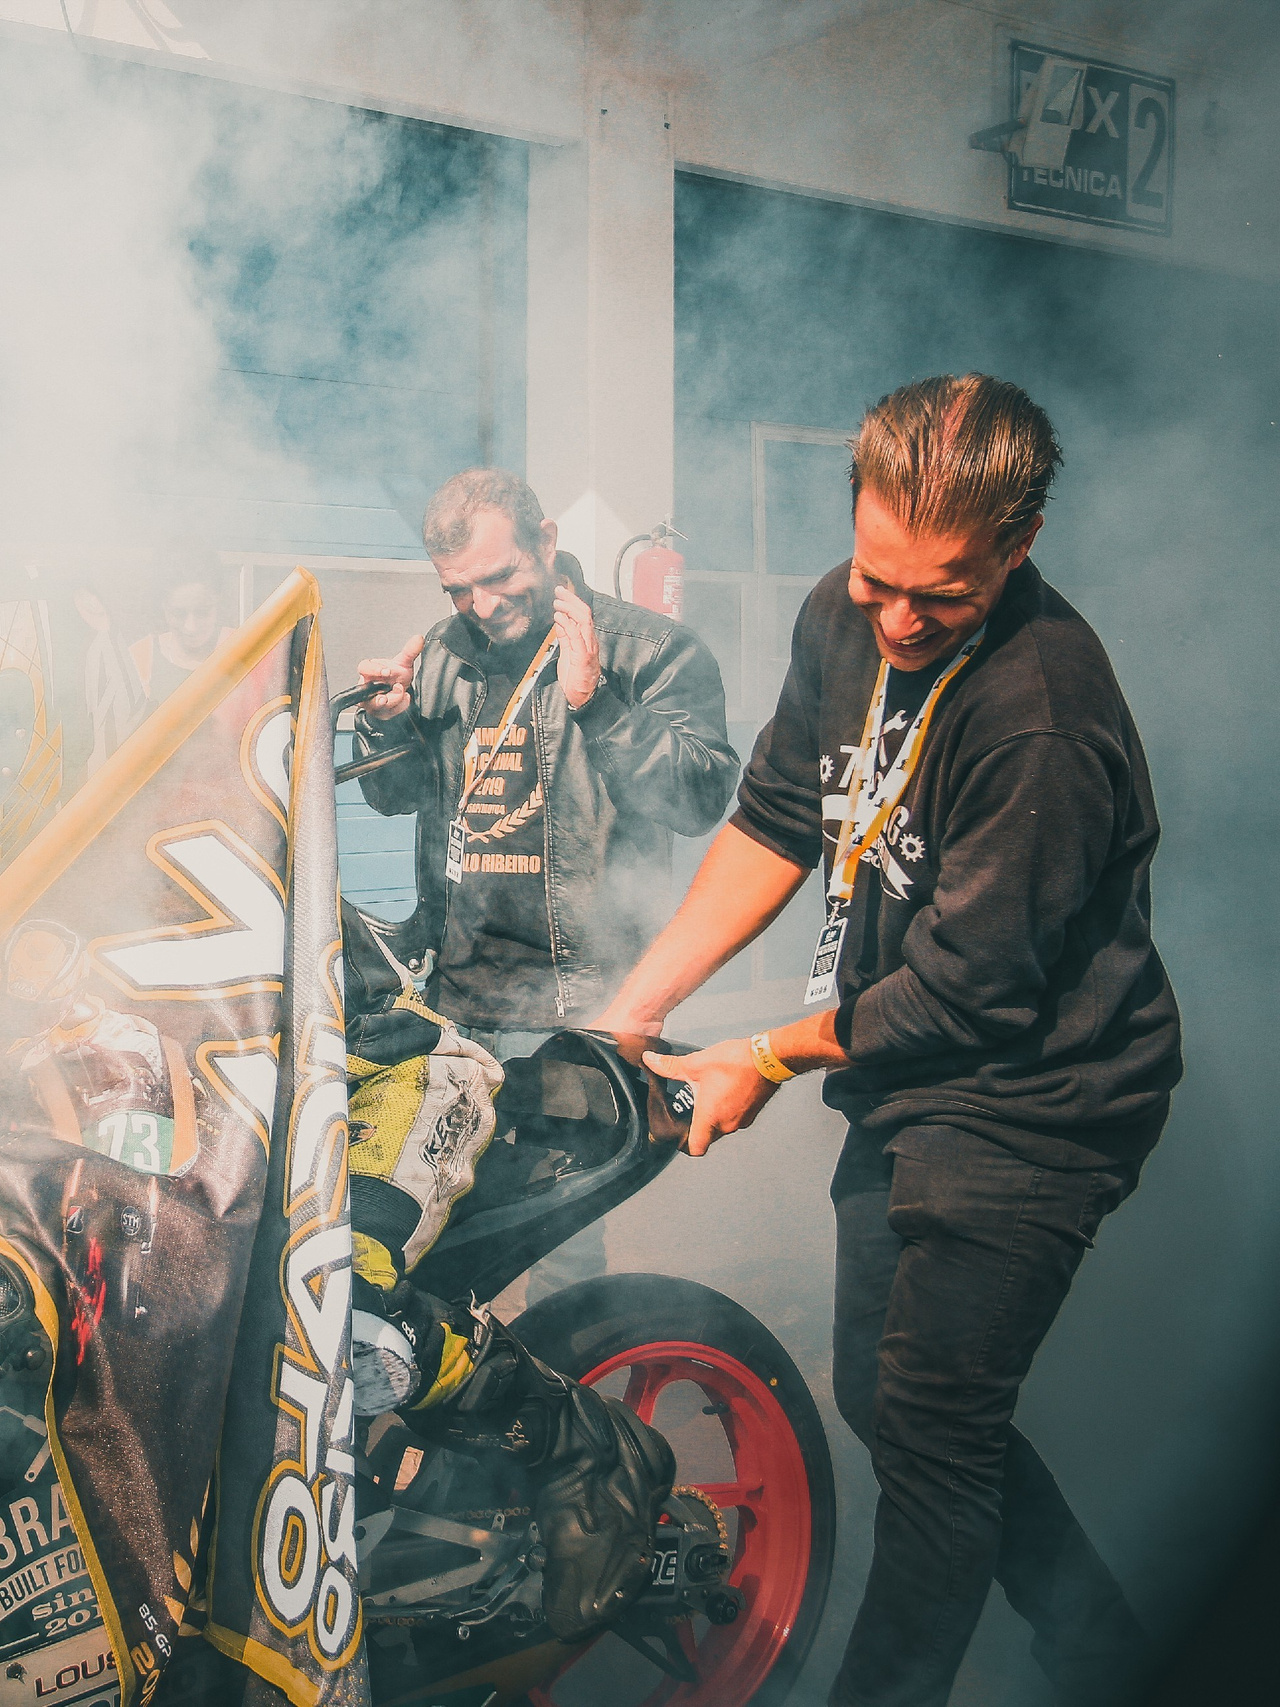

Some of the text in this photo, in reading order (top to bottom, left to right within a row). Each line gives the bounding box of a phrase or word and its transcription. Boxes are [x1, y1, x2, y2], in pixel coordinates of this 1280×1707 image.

[1131, 97, 1166, 209] 2
[1021, 165, 1124, 199] TECNICA
[481, 854, 541, 874] RIBEIRO
[97, 1113, 161, 1174] 73
